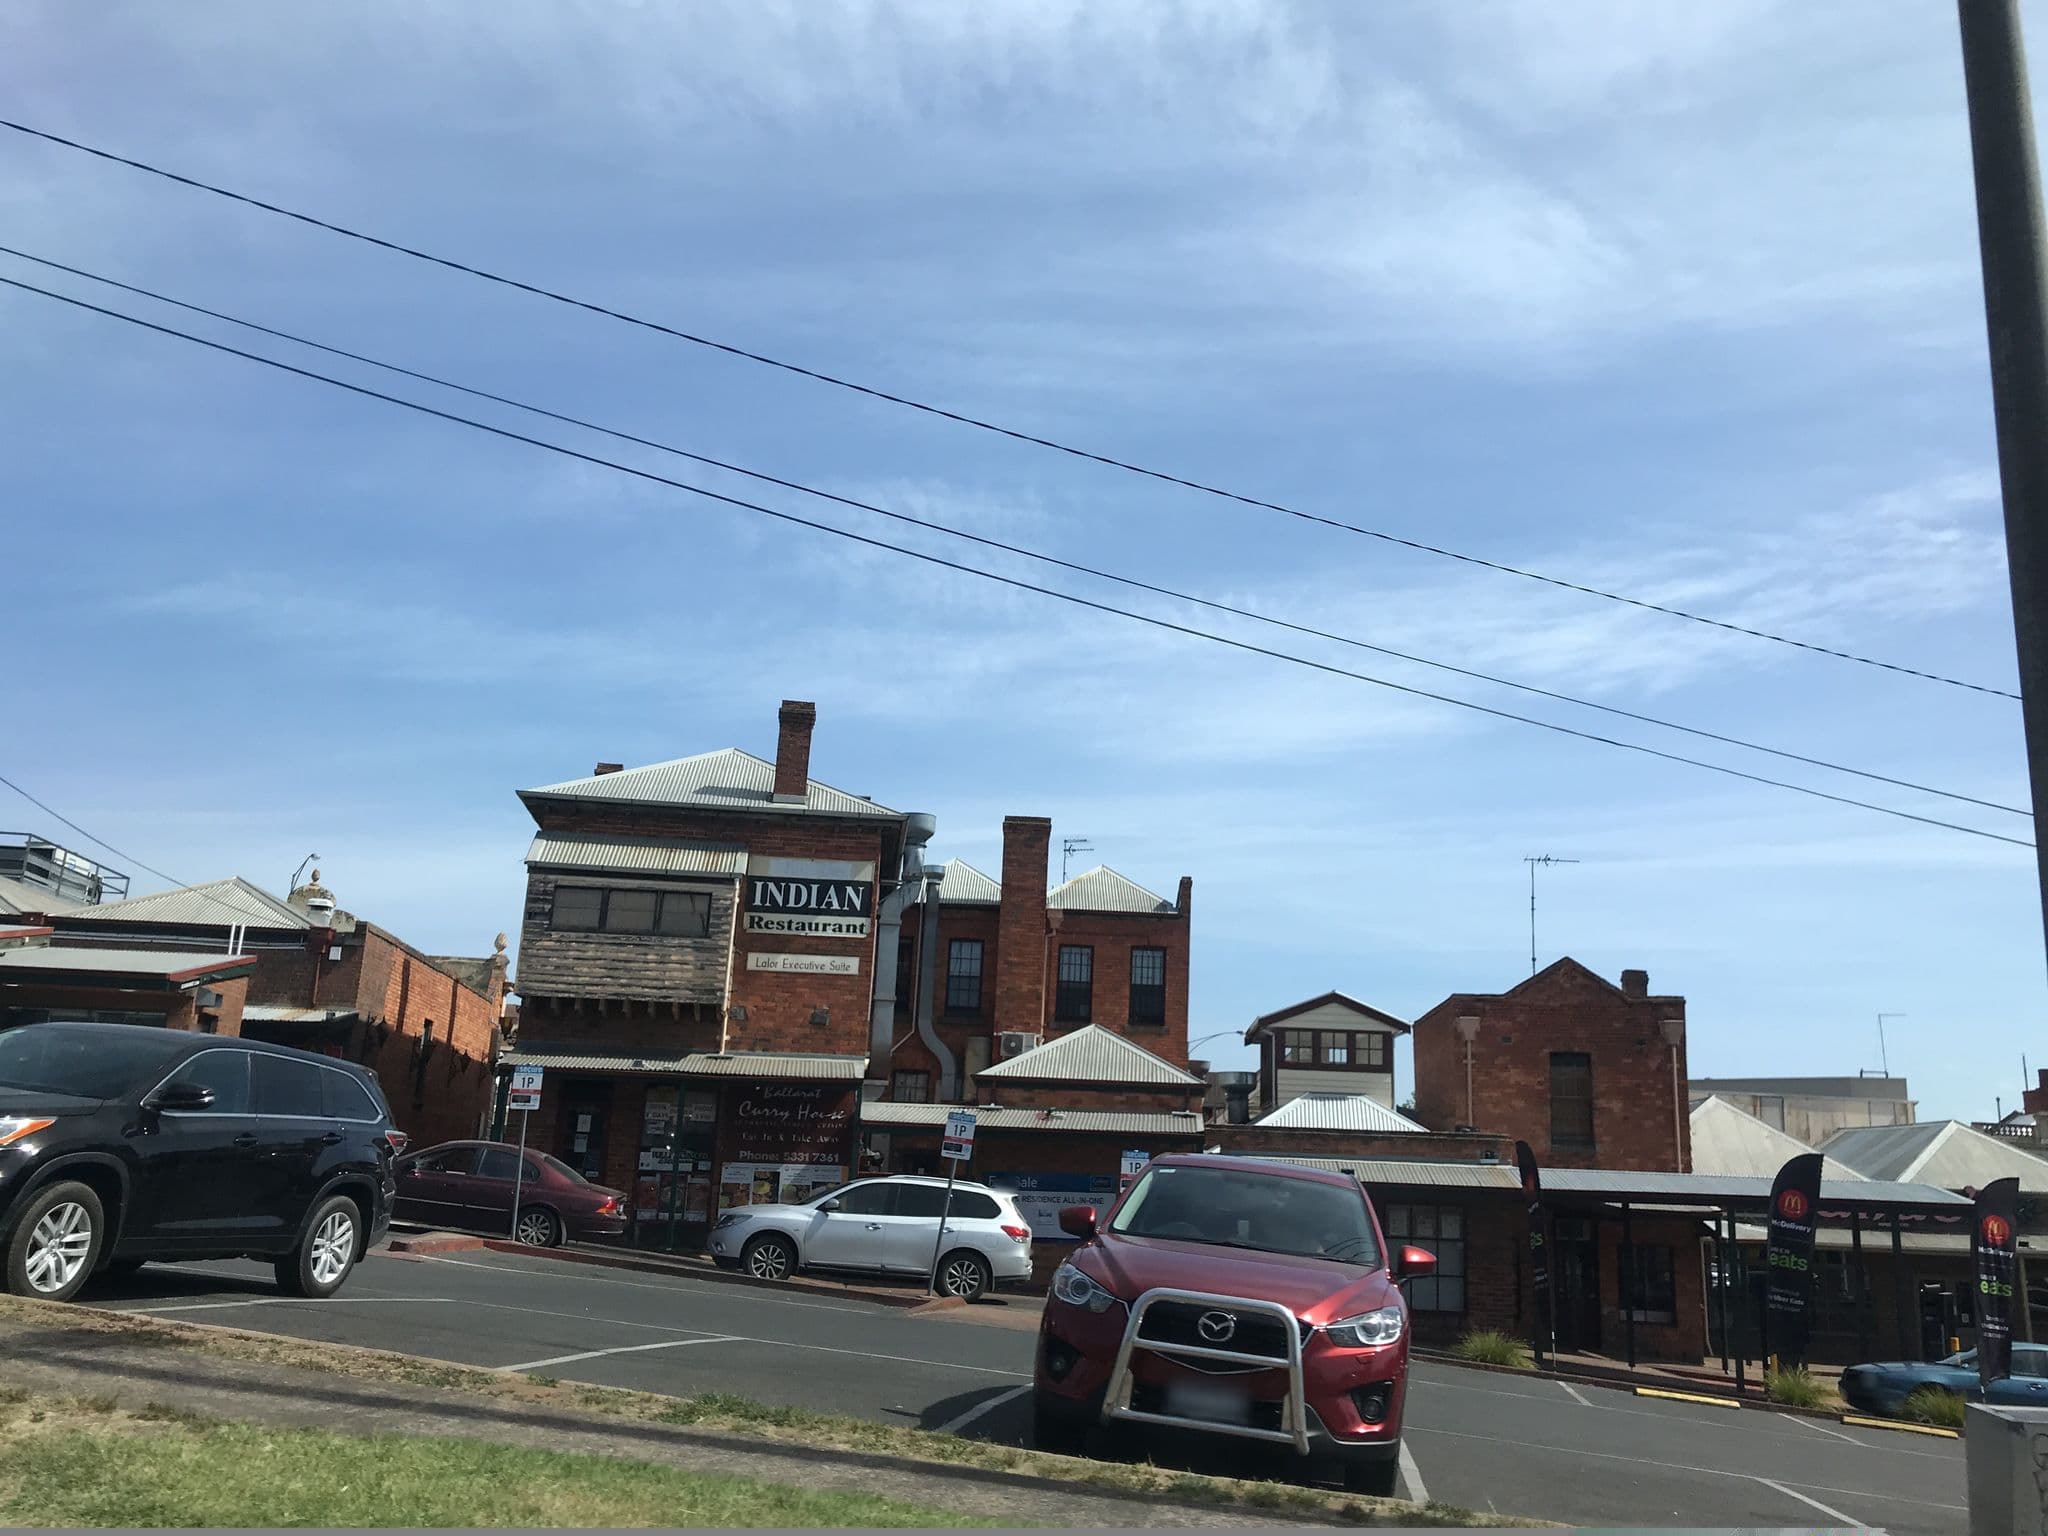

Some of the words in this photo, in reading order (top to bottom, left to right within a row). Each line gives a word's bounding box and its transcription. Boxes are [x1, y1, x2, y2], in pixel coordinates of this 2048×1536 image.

[752, 881, 864, 911] INDIAN
[748, 914, 866, 935] Restaurant
[755, 957, 778, 969] Lalor
[782, 958, 826, 971] Executive
[829, 960, 851, 972] Suite
[522, 1077, 534, 1088] 1P
[739, 1100, 791, 1120] Curry
[954, 1124, 967, 1136] 1P
[739, 1151, 780, 1161] Phone:
[1129, 1162, 1142, 1173] 1P
[1769, 1252, 1808, 1271] eats
[1980, 1280, 2013, 1297] eats
